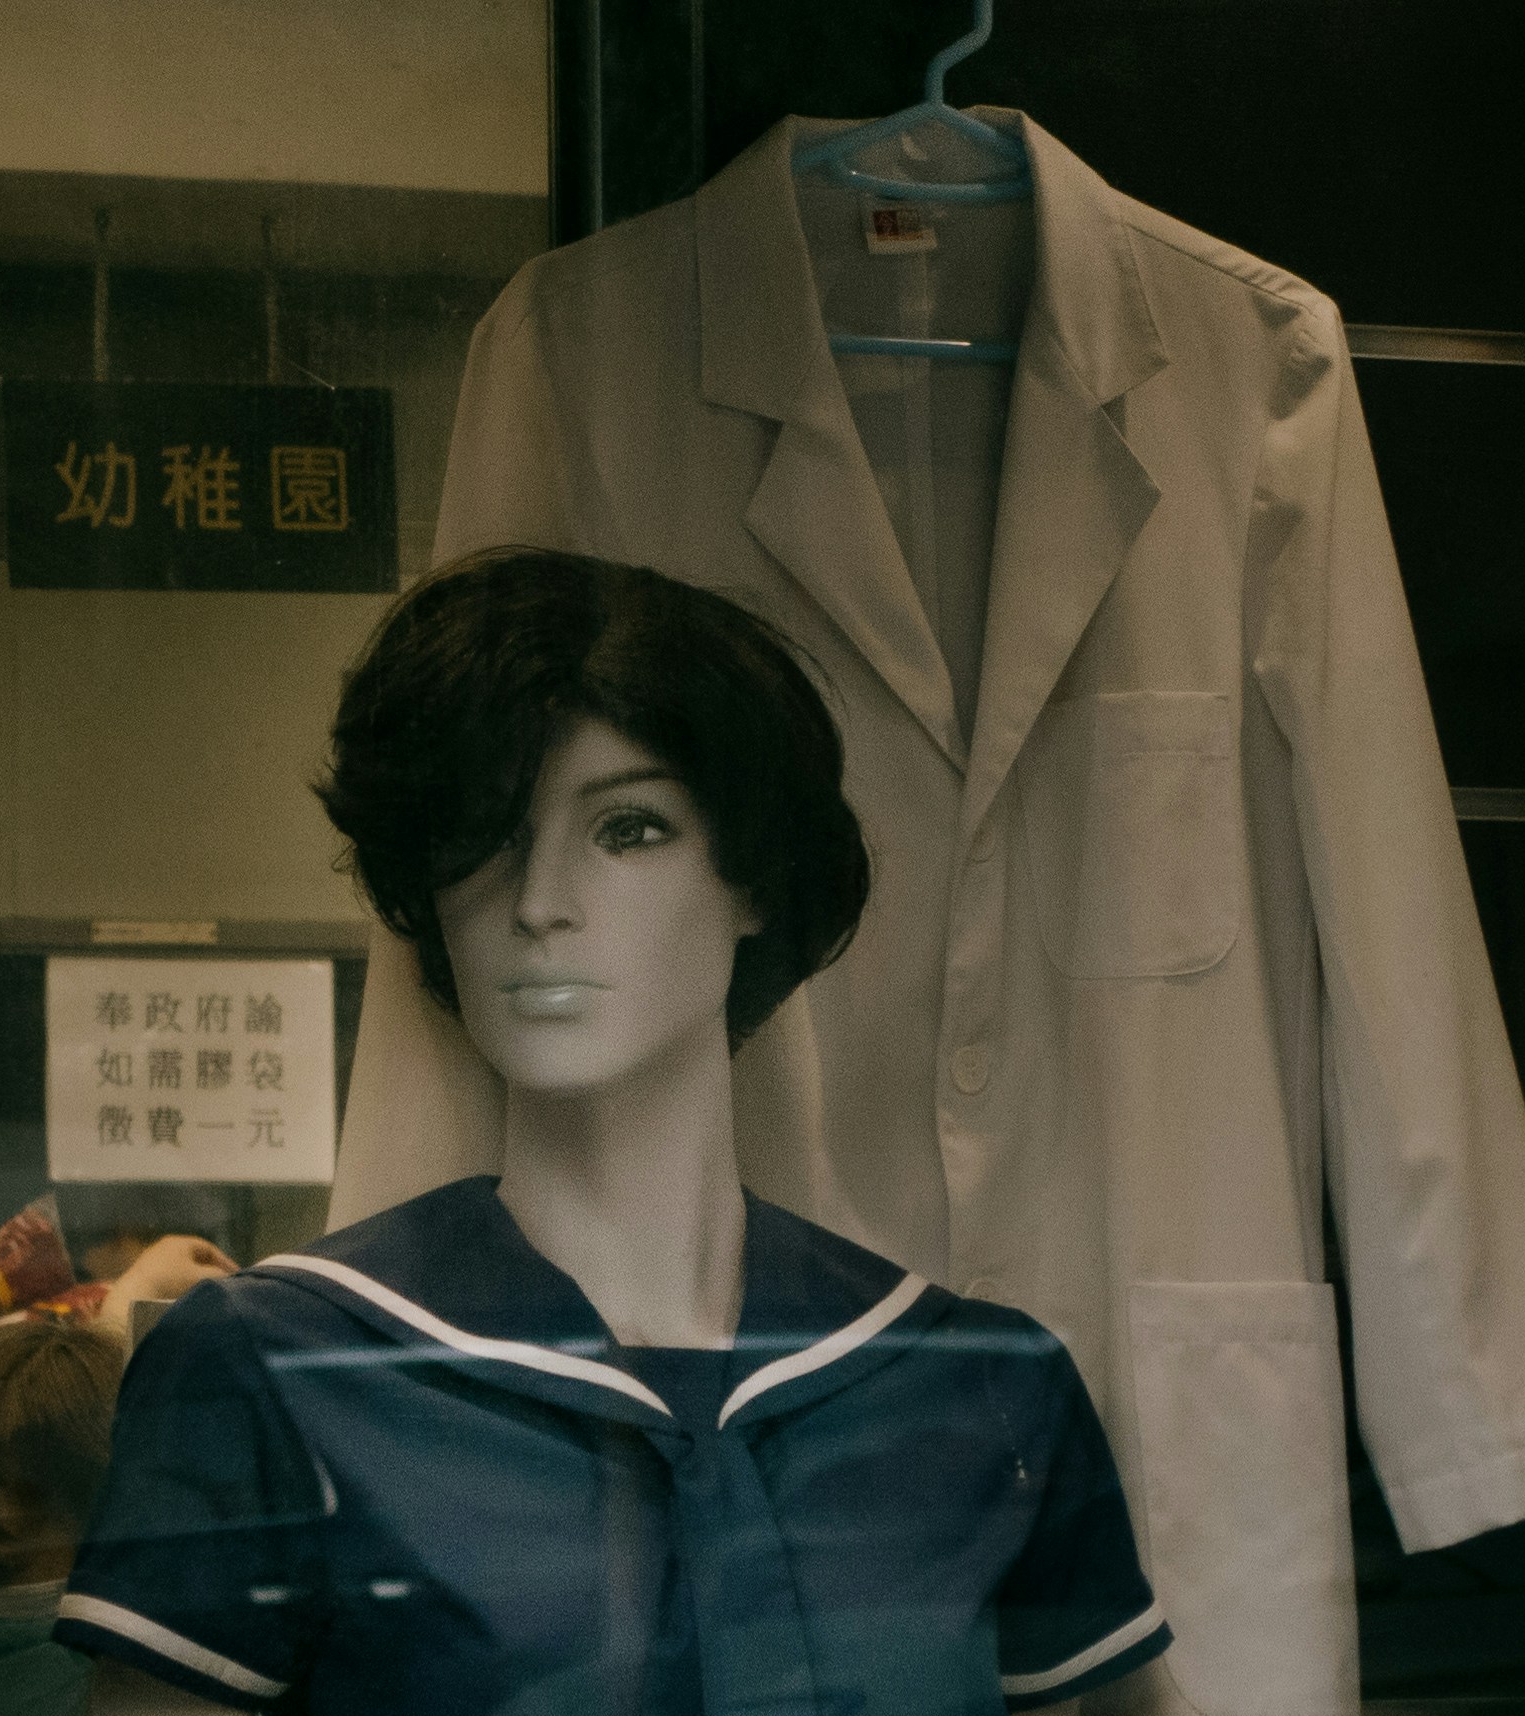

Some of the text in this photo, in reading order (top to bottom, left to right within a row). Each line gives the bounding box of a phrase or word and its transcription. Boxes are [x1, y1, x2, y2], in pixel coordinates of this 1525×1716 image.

[54, 441, 352, 531] 幼稚園
[95, 1049, 284, 1091] 如需膠袋
